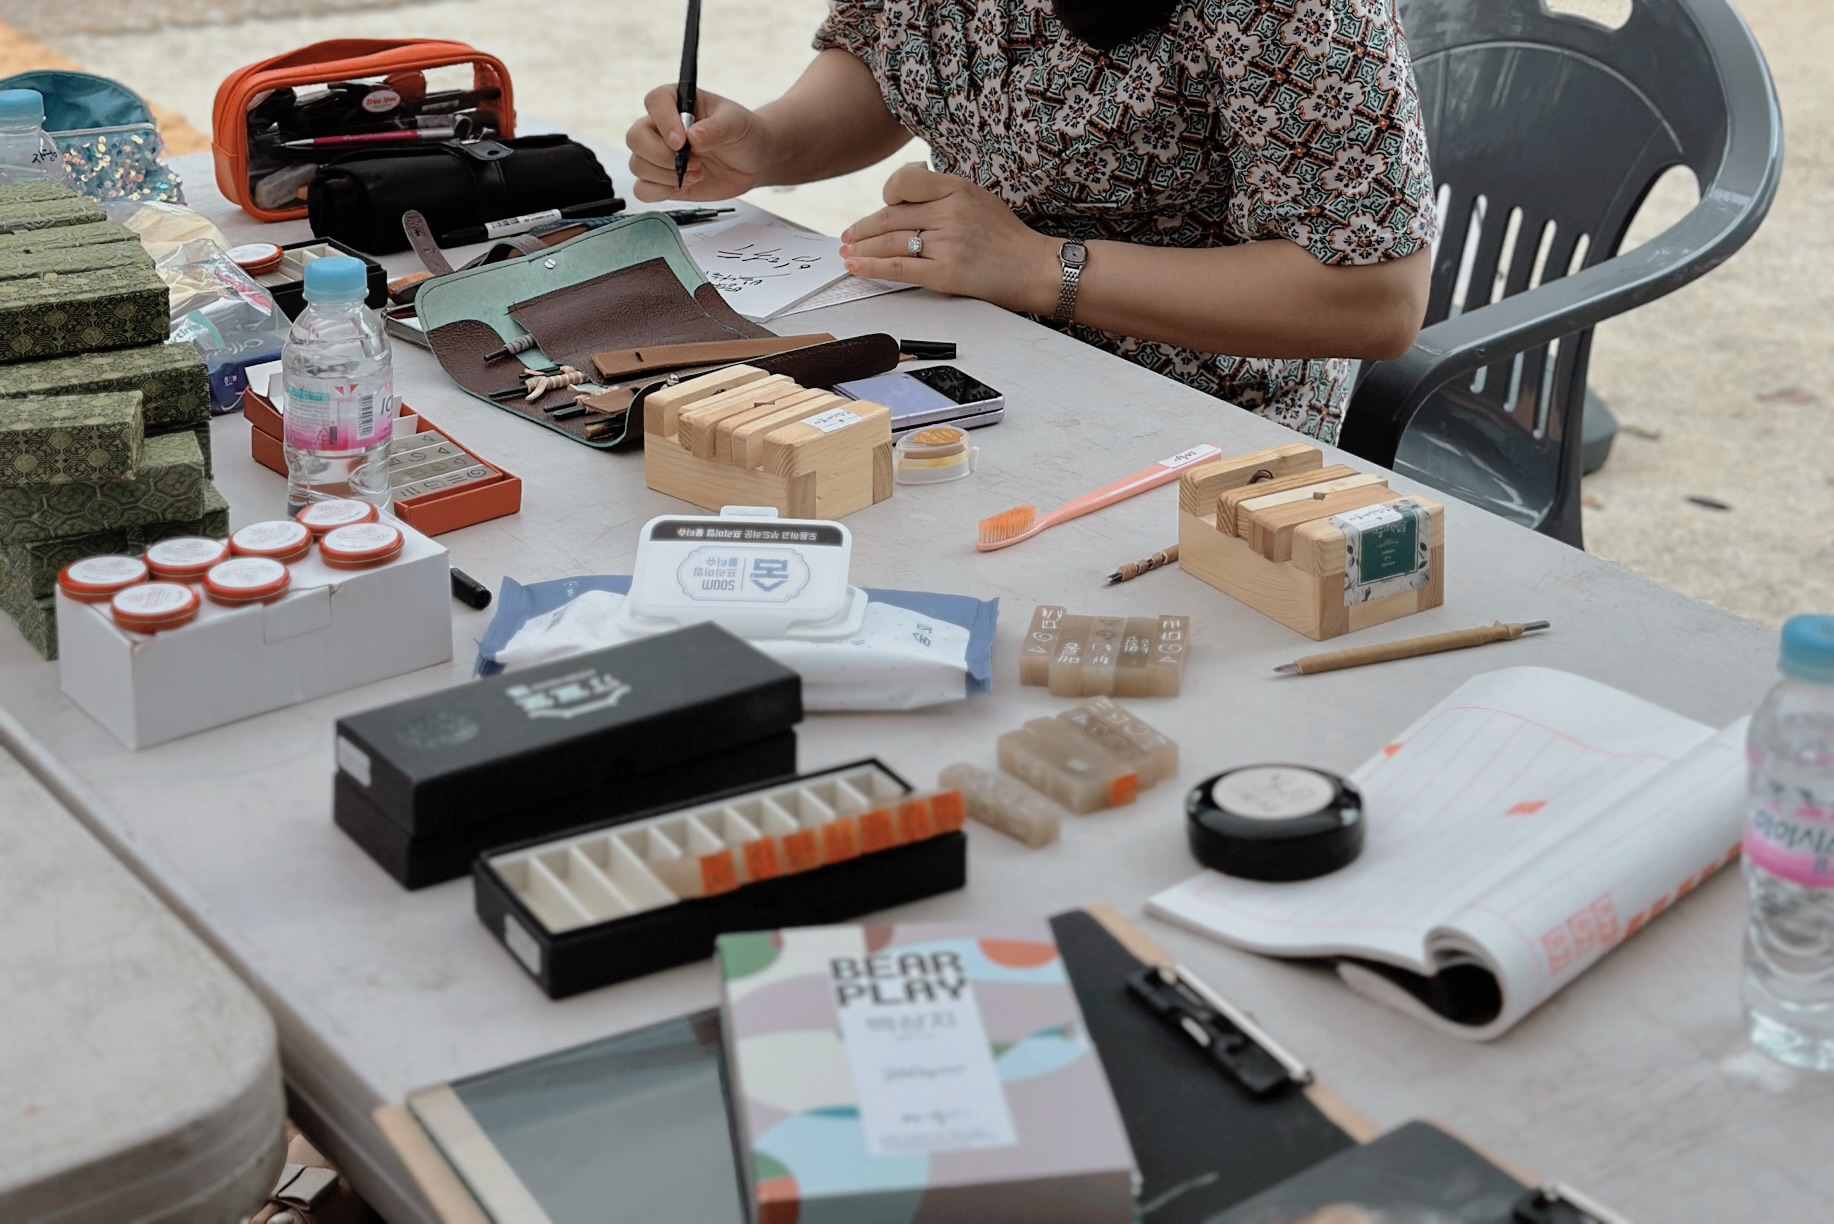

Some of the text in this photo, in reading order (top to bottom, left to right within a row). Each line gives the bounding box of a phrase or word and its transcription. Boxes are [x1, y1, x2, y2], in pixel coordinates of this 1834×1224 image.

[677, 527, 704, 538] 물티슈
[706, 527, 742, 538] 프리미엄
[744, 528, 780, 539] 부드러운
[705, 557, 739, 568] 물티슈
[693, 567, 738, 578] 프리미엄
[751, 558, 789, 592] 숨
[829, 950, 964, 981] BEAR
[835, 978, 968, 1008] PLAY
